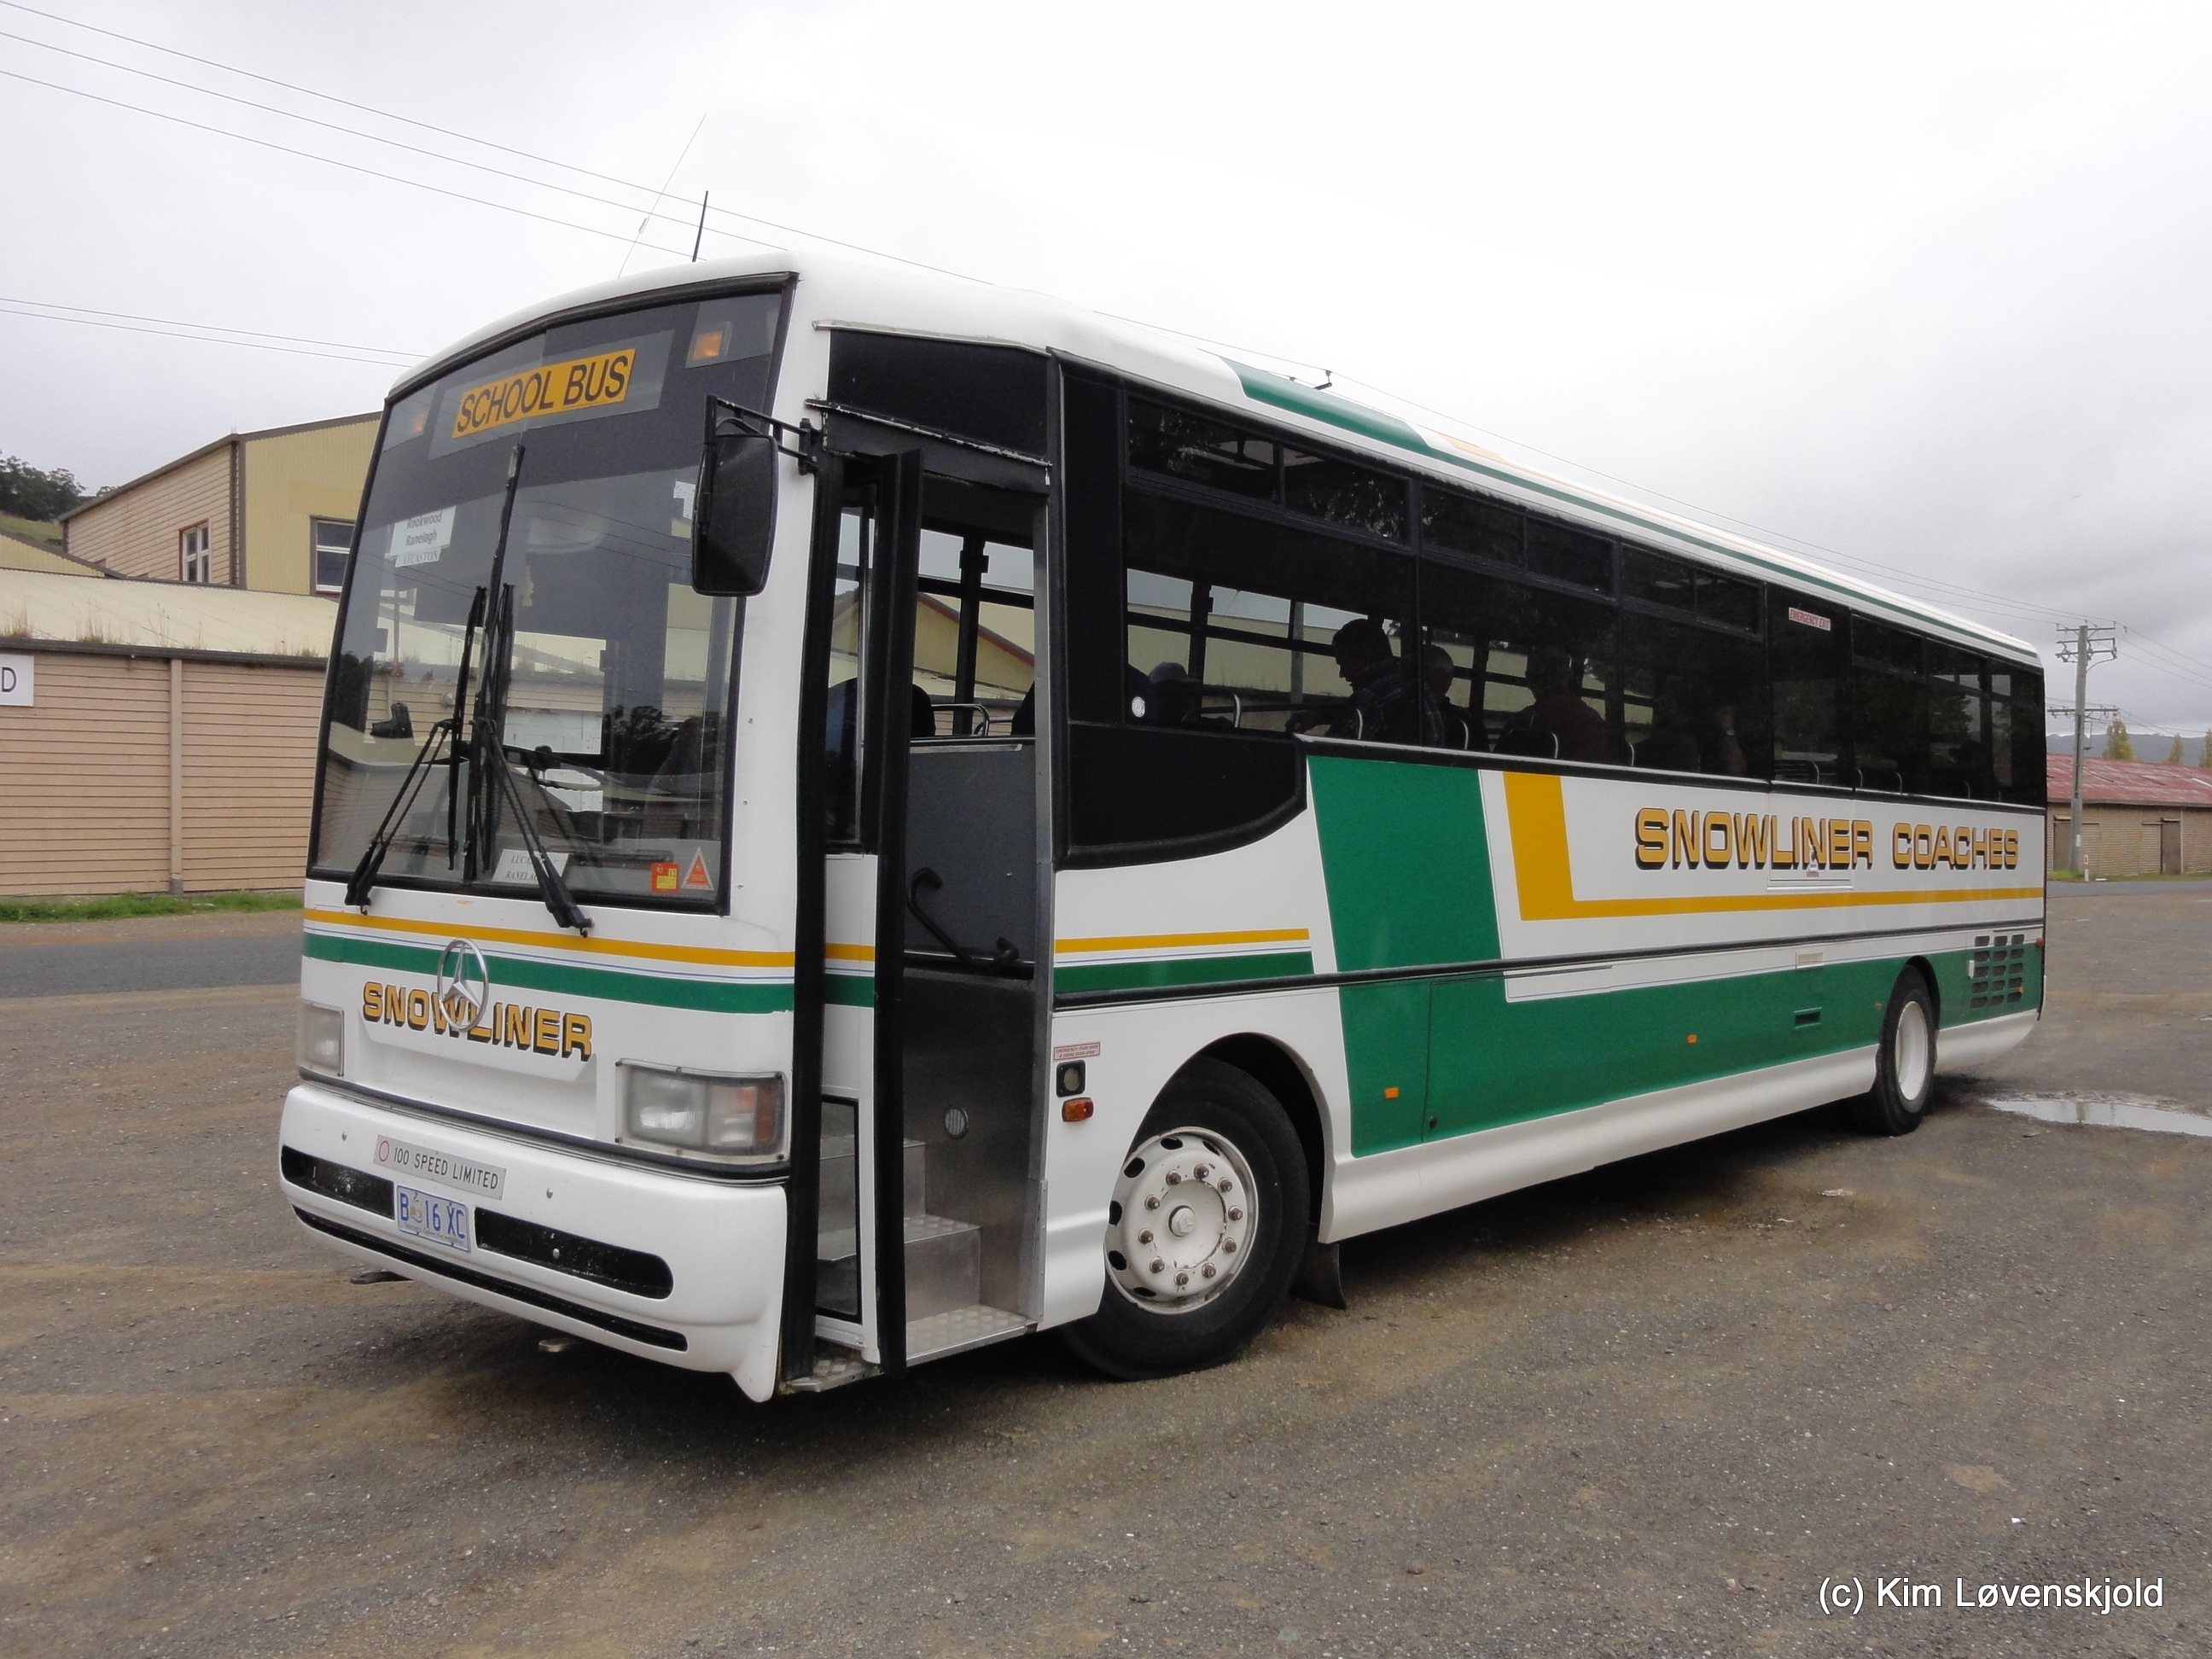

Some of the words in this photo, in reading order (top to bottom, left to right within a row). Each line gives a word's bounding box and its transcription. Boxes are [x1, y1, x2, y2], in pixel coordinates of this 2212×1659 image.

[457, 370, 555, 433] SCHOOL
[562, 355, 628, 406] BUS
[405, 529, 438, 546] Ranelagh
[2, 667, 17, 692] D
[1635, 806, 1874, 870] SNOWLINER
[1892, 822, 2020, 870] COACHES
[363, 981, 593, 1062] SNOWLINER
[393, 1147, 410, 1166] 100
[414, 1153, 448, 1176] SPEED
[452, 1162, 499, 1190] LIMITED
[399, 1192, 409, 1221] B
[425, 1200, 441, 1231] 16
[446, 1205, 466, 1239] XC
